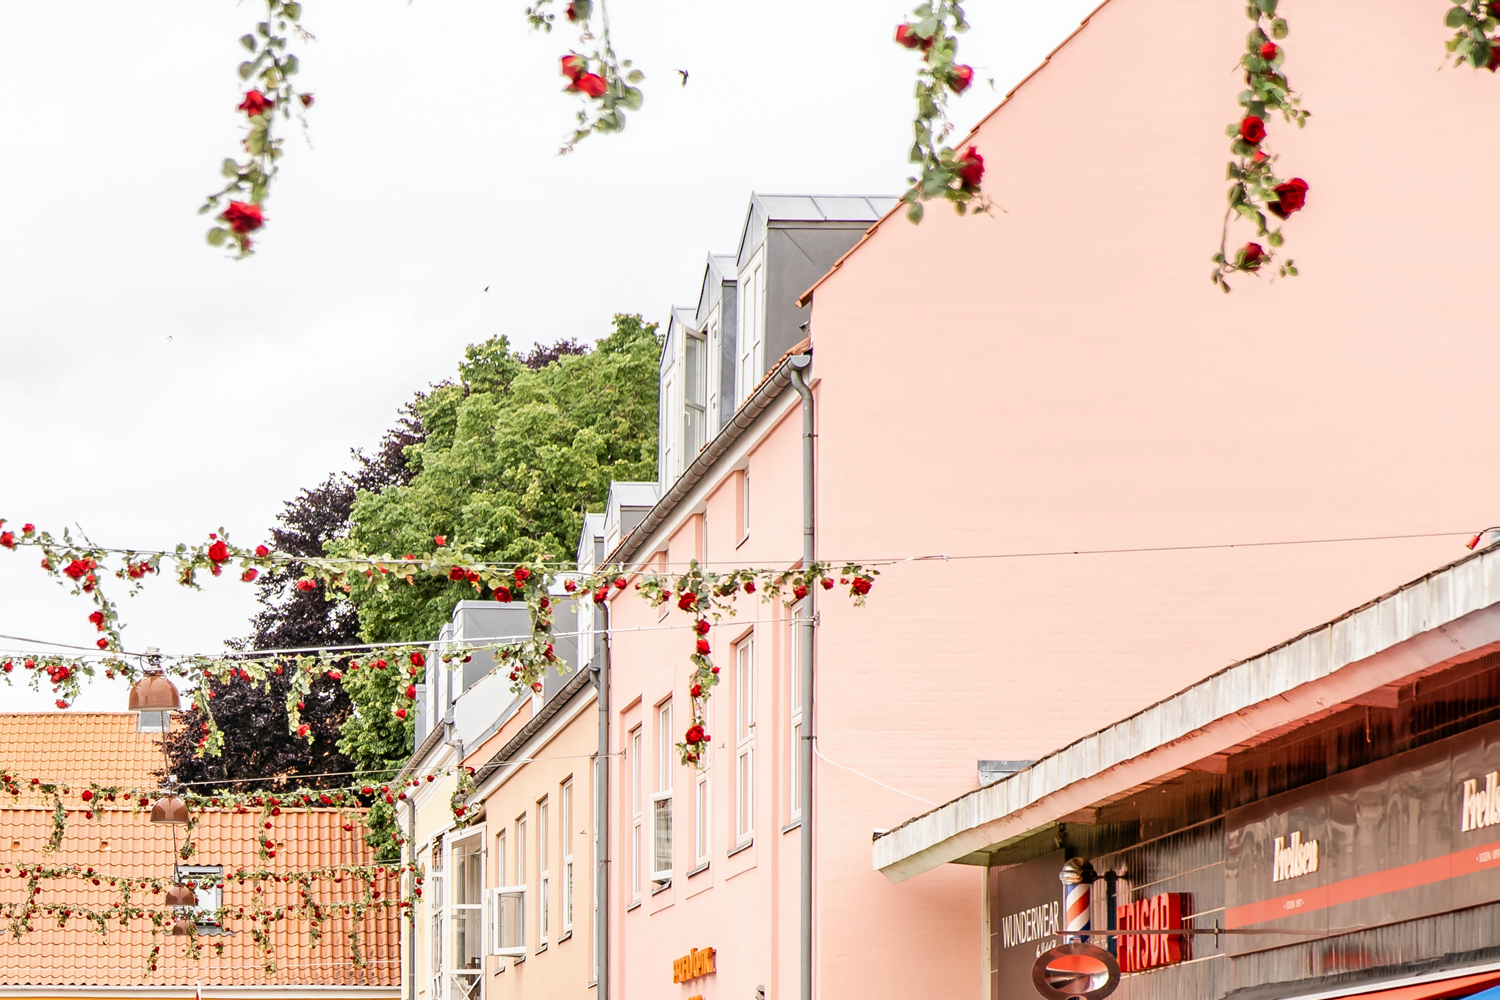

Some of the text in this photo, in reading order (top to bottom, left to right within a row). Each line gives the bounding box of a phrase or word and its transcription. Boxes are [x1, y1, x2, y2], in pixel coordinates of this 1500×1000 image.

[1272, 831, 1319, 882] Frellsen
[1002, 900, 1060, 949] WUNDERWEAR
[1117, 892, 1180, 973] FRISØR
